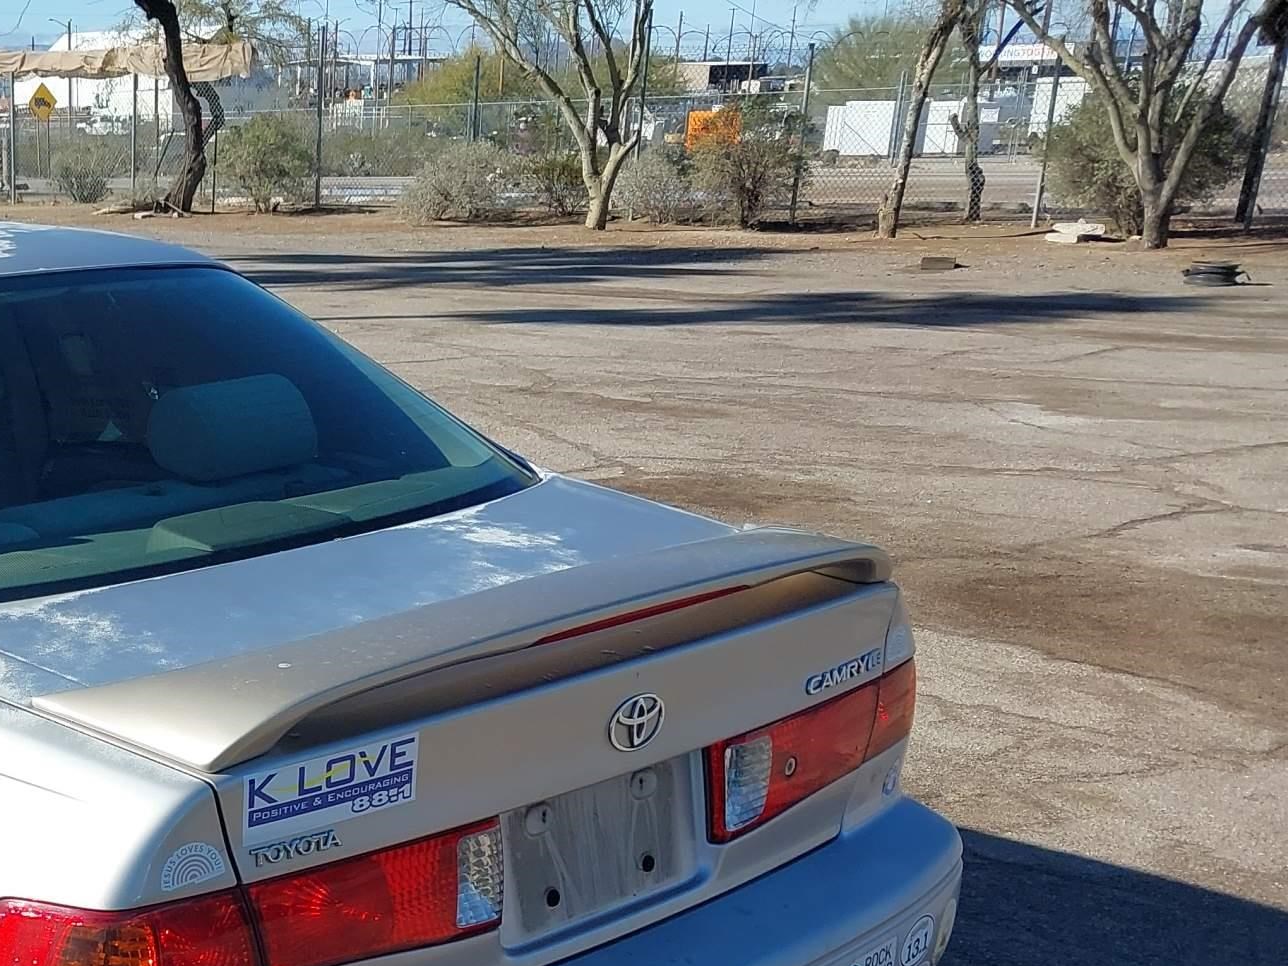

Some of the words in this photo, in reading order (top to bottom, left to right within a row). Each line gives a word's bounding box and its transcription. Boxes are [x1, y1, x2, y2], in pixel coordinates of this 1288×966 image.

[806, 656, 869, 695] CAMRY
[248, 772, 278, 810] K
[298, 736, 416, 797] LOVE
[252, 800, 309, 822] POSITIVE
[312, 796, 323, 807] &
[327, 773, 410, 802] ENCOURAGING
[162, 859, 176, 889] JESUS
[176, 844, 205, 860] LOVES
[250, 829, 343, 867] TOYOTA
[904, 930, 929, 964] 13.1
